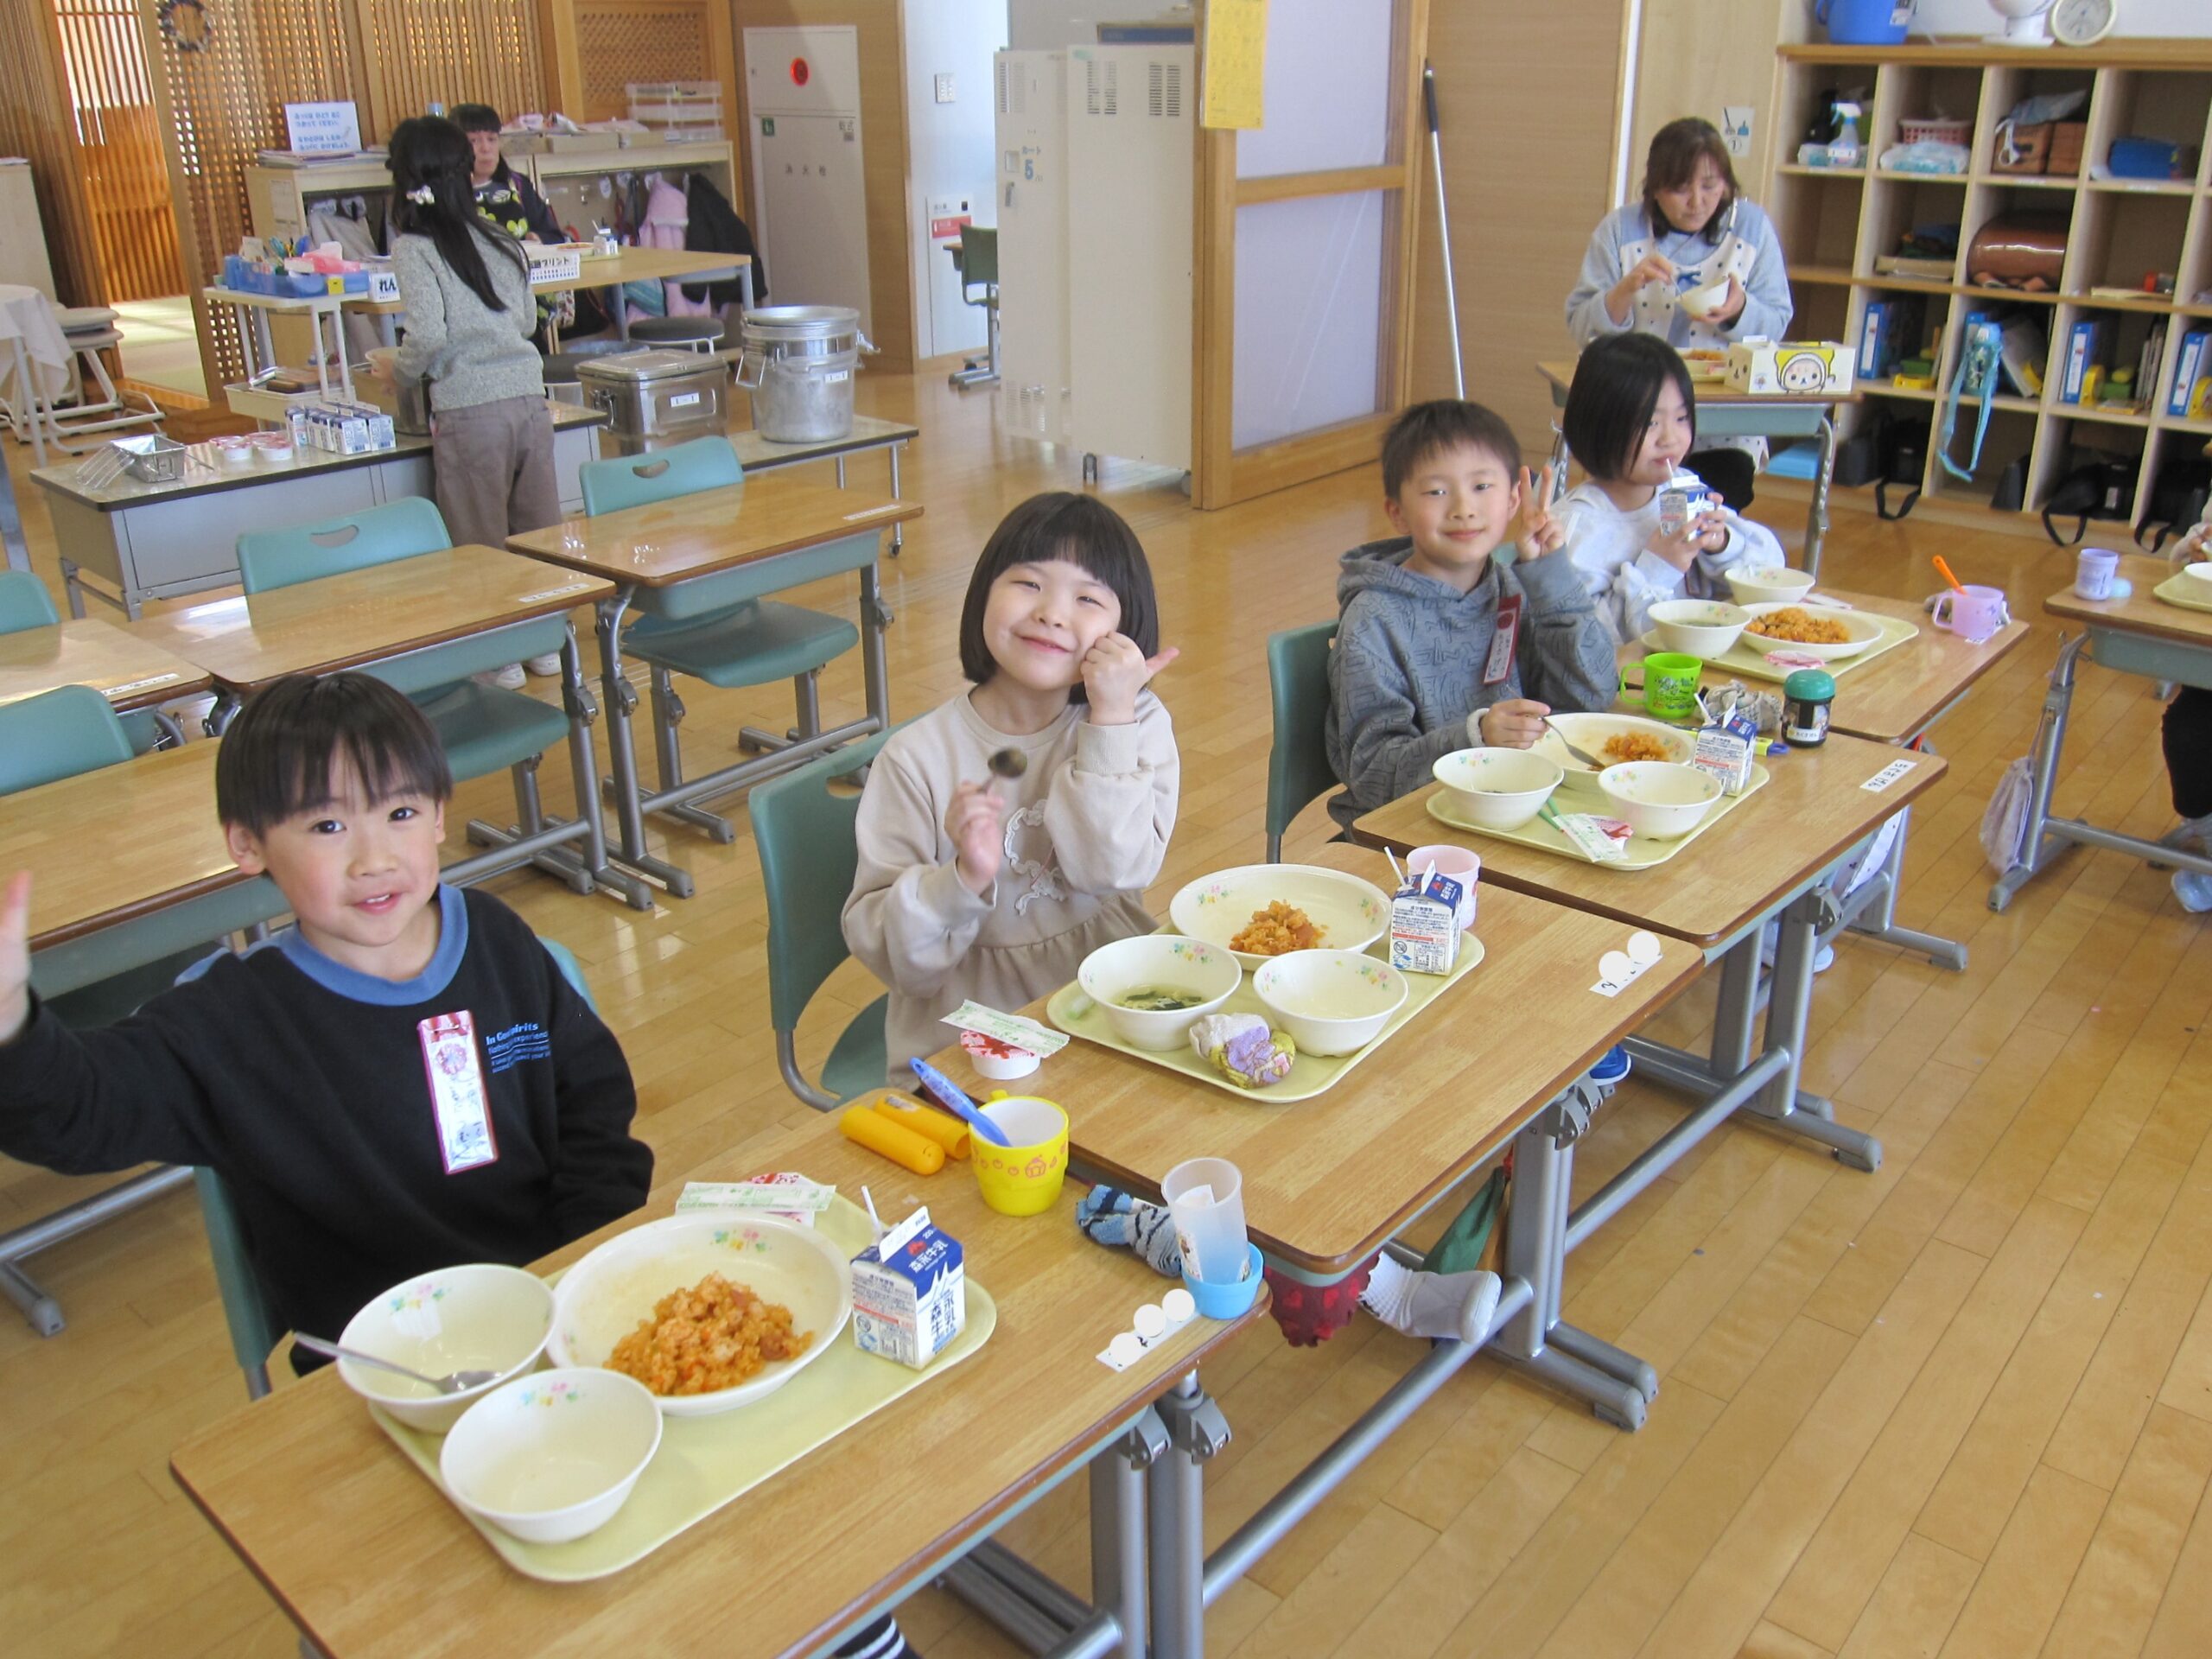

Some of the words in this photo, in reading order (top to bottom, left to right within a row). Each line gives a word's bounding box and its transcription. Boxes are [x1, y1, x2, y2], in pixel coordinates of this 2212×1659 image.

[486, 1035, 496, 1046] In
[908, 1240, 949, 1274] 森永牛乳
